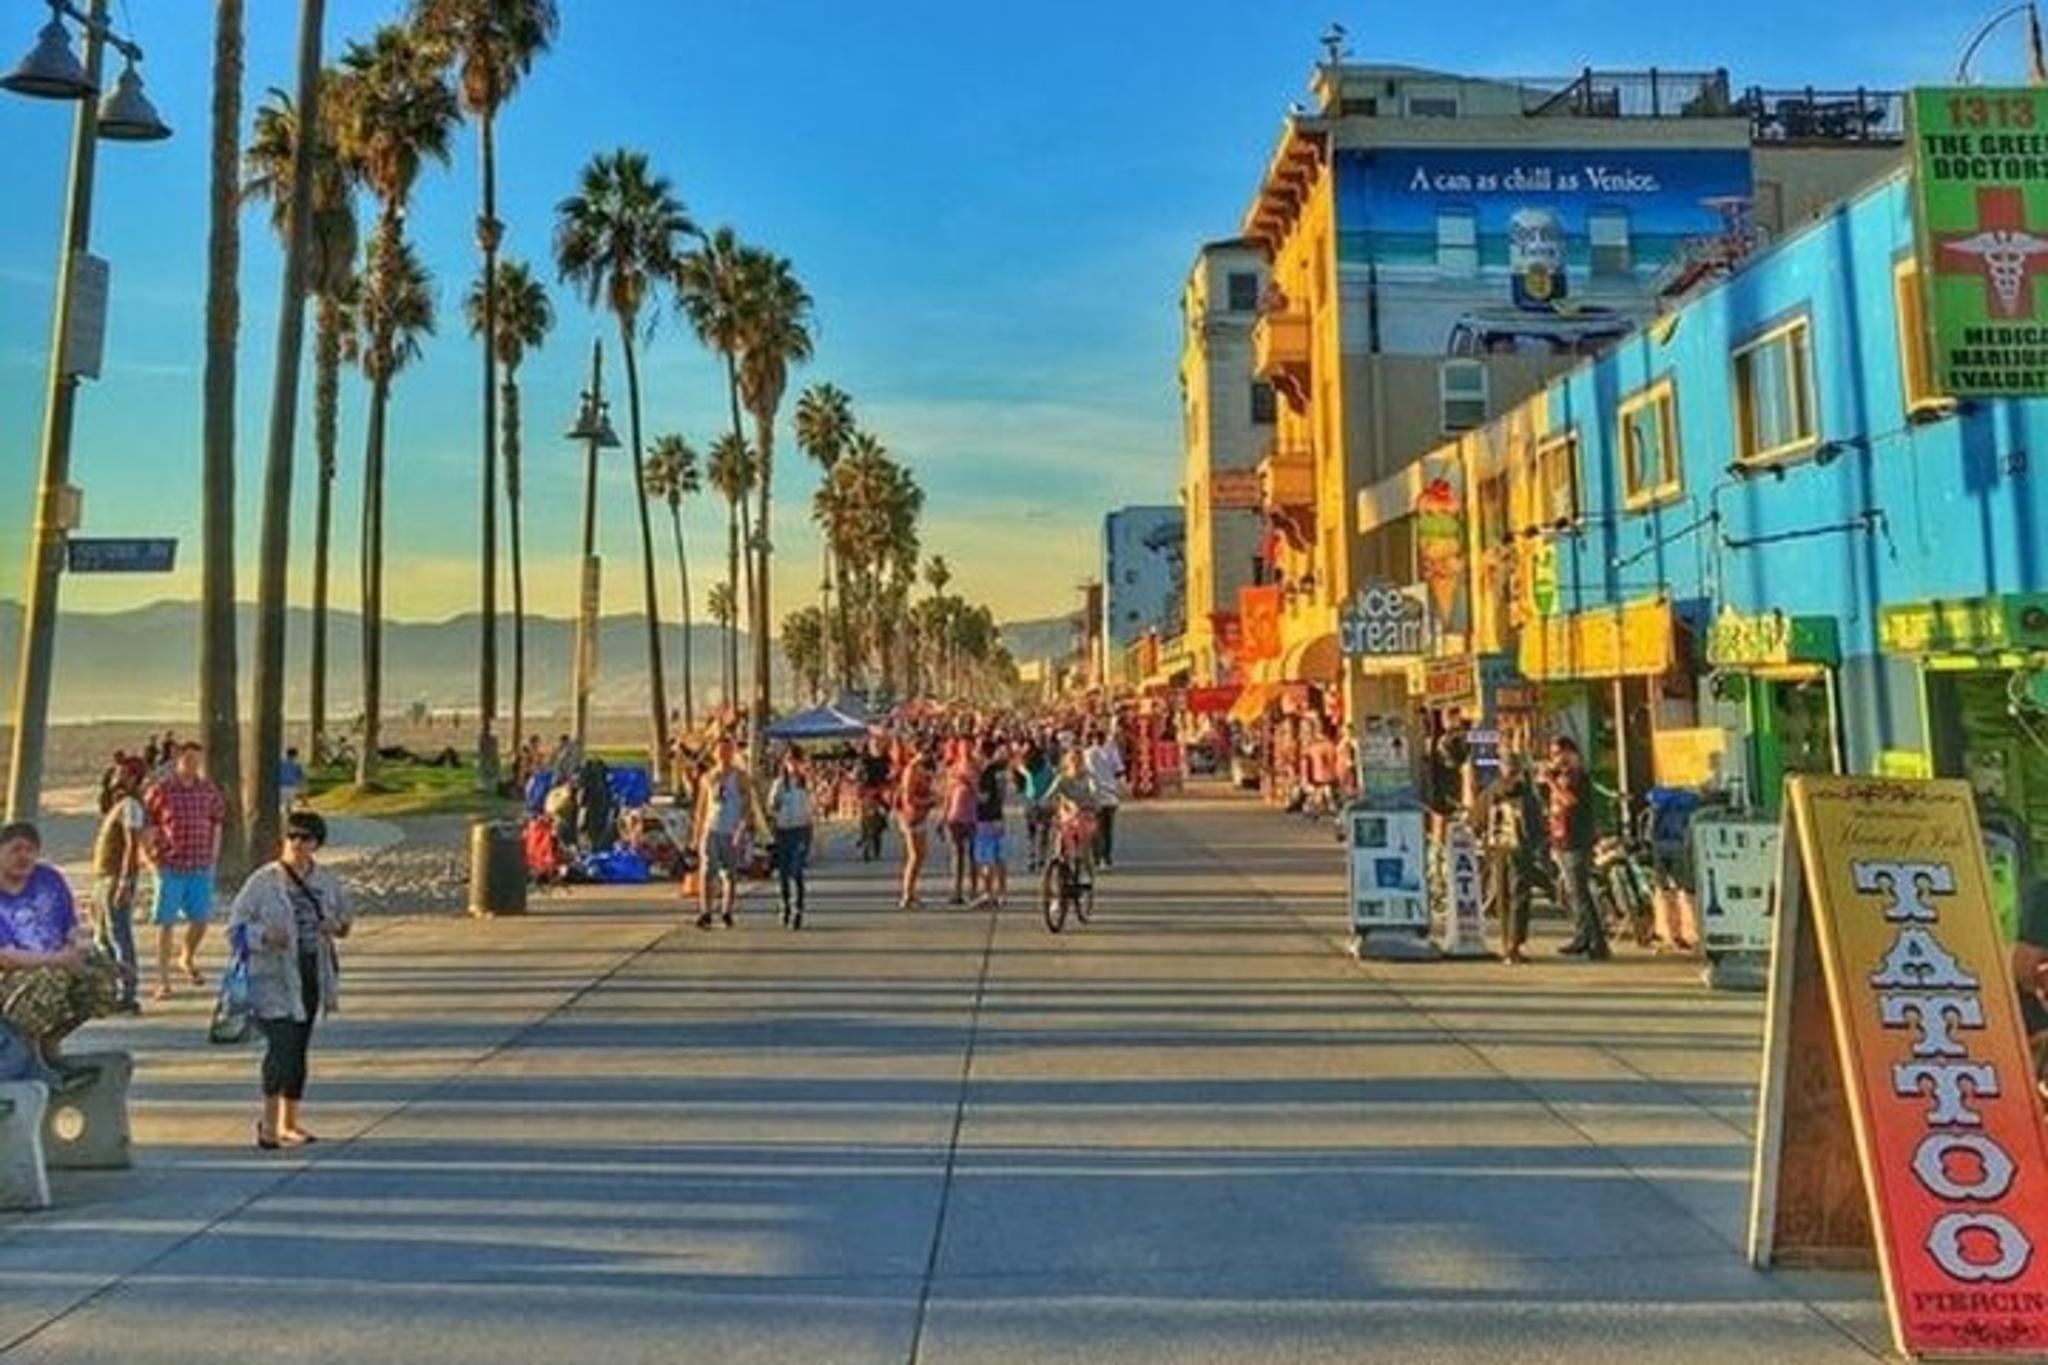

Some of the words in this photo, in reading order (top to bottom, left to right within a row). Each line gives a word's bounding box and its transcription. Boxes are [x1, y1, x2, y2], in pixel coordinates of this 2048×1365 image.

[1922, 135, 1972, 156] THE
[1980, 135, 2048, 156] GREE
[1410, 167, 1430, 190] A
[1434, 174, 1471, 190] can
[1476, 174, 1498, 190] as
[1503, 167, 1551, 190] chill
[1556, 174, 1579, 190] as
[1456, 853, 1477, 918] ATM
[1852, 861, 2033, 1284] TATTOO
